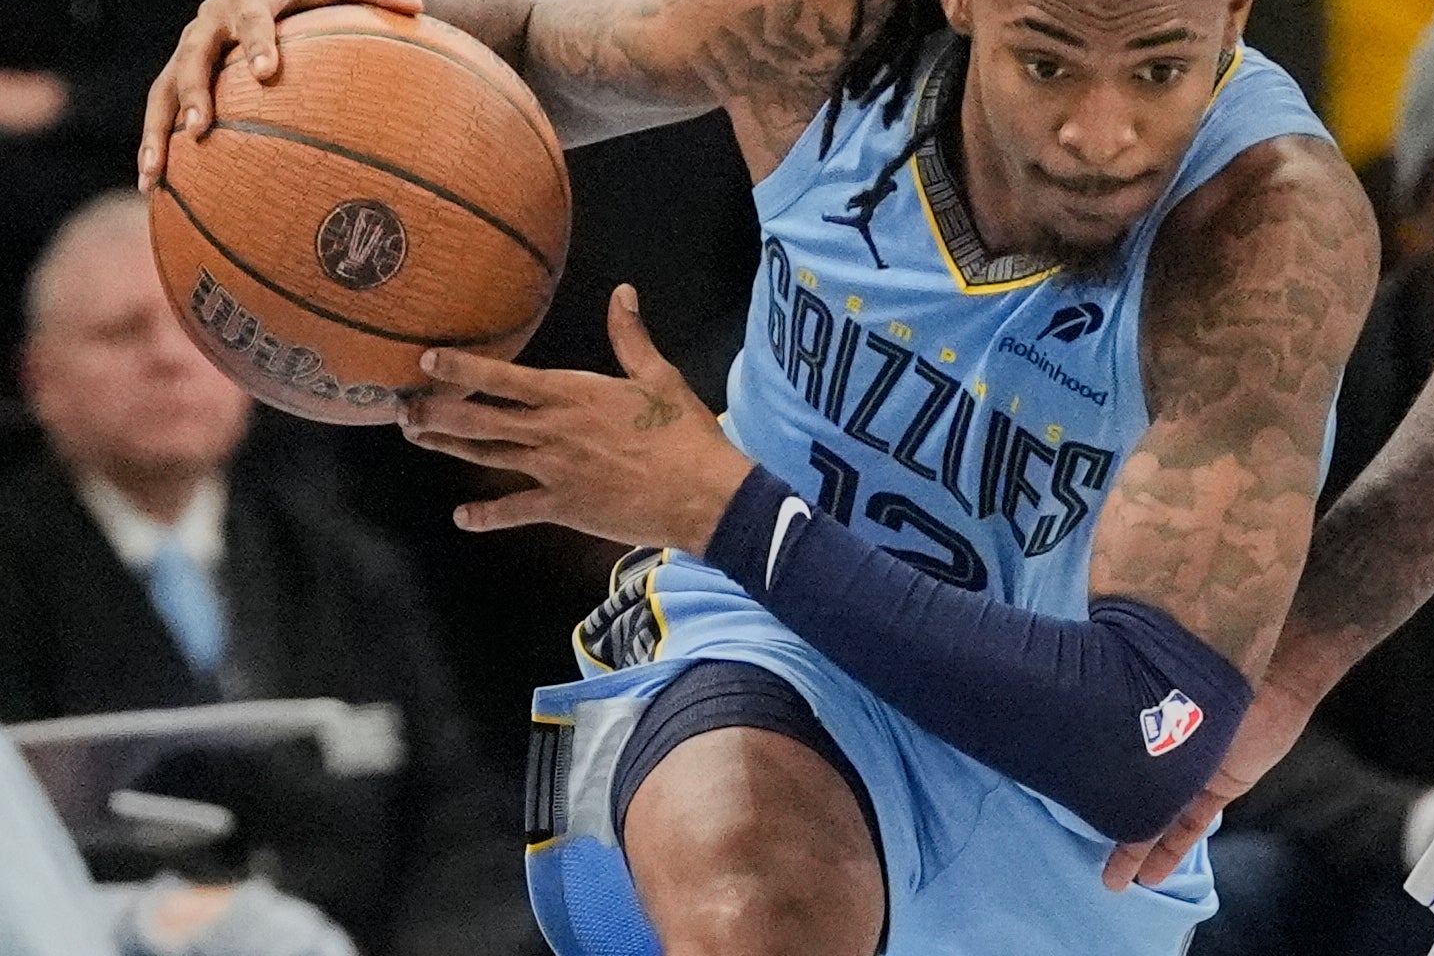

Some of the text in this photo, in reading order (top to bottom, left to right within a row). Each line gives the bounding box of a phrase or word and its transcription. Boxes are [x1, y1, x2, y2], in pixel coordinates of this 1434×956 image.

[191, 262, 410, 408] Wilso
[764, 235, 1117, 560] GRIZZLIES
[998, 336, 1109, 407] Robinhood
